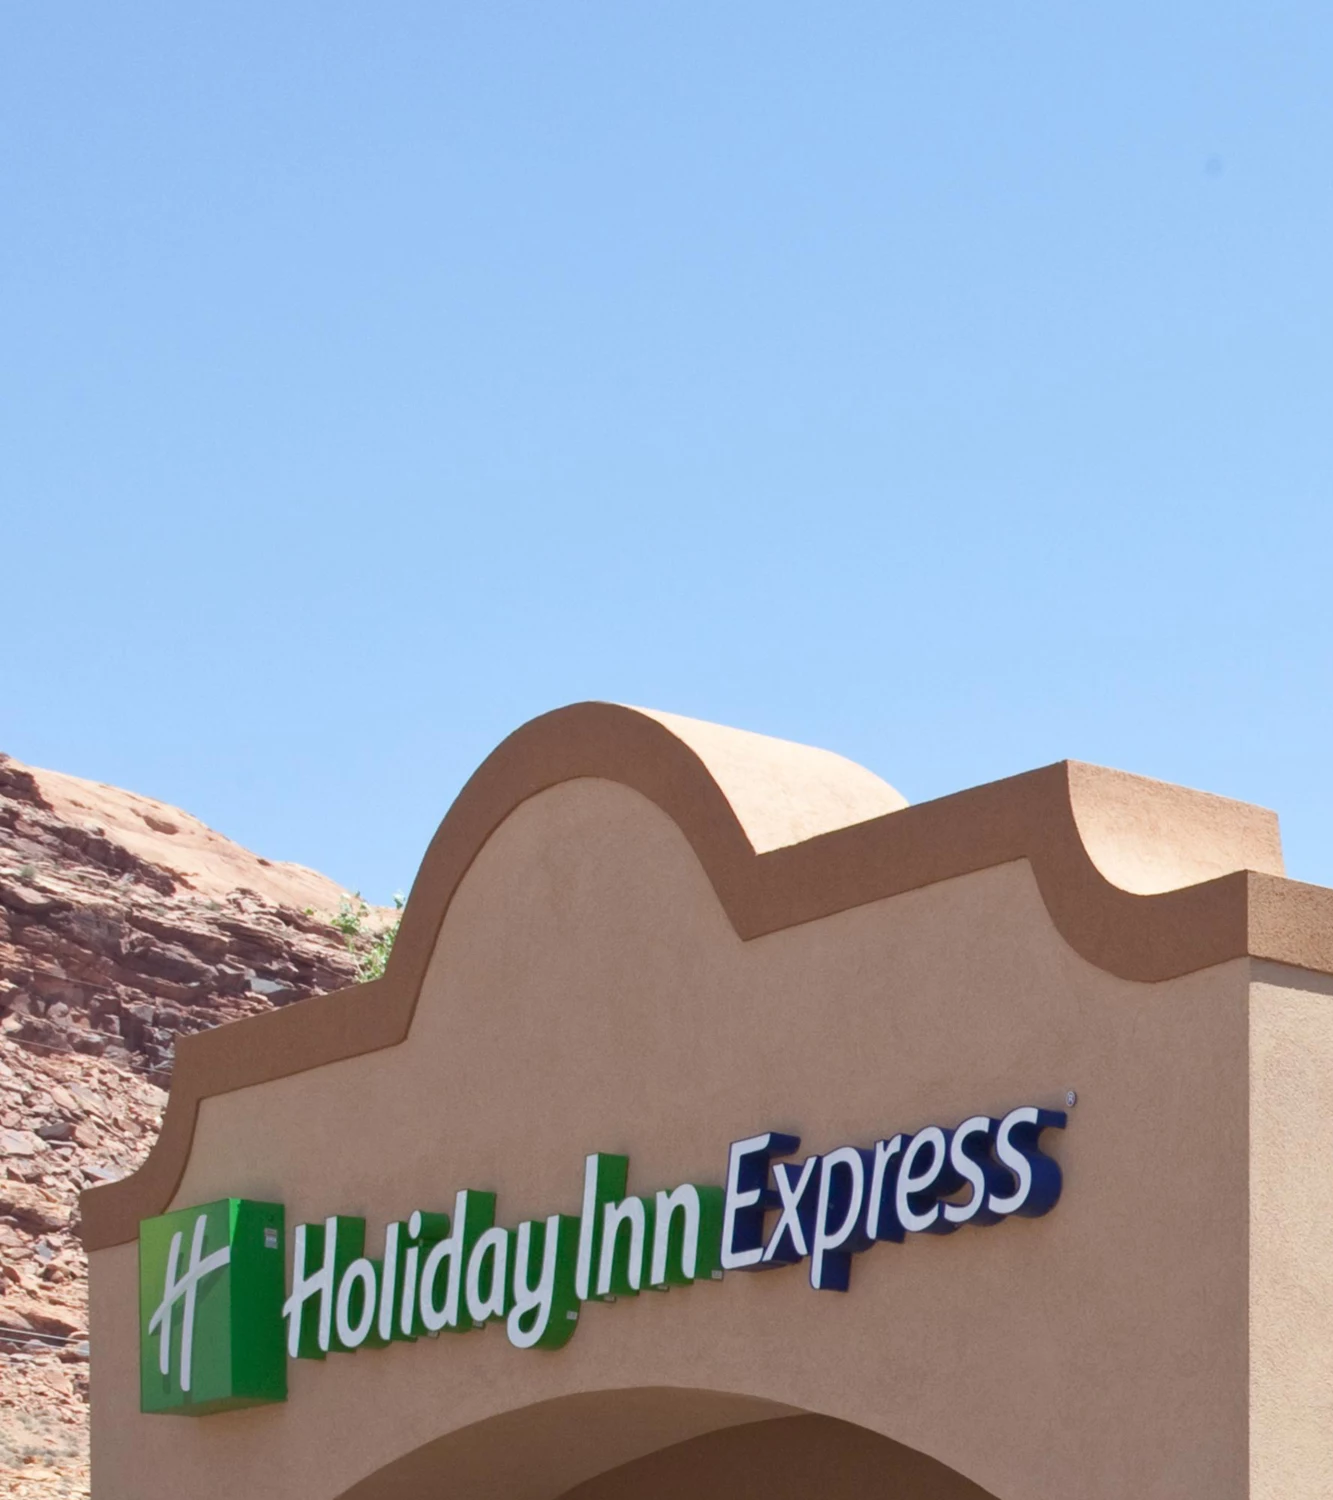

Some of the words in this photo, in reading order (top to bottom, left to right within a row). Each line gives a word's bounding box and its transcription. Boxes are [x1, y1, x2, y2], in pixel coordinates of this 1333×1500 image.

[283, 1188, 564, 1358] Holiday
[576, 1152, 704, 1300] Inn
[720, 1105, 1042, 1290] Express
